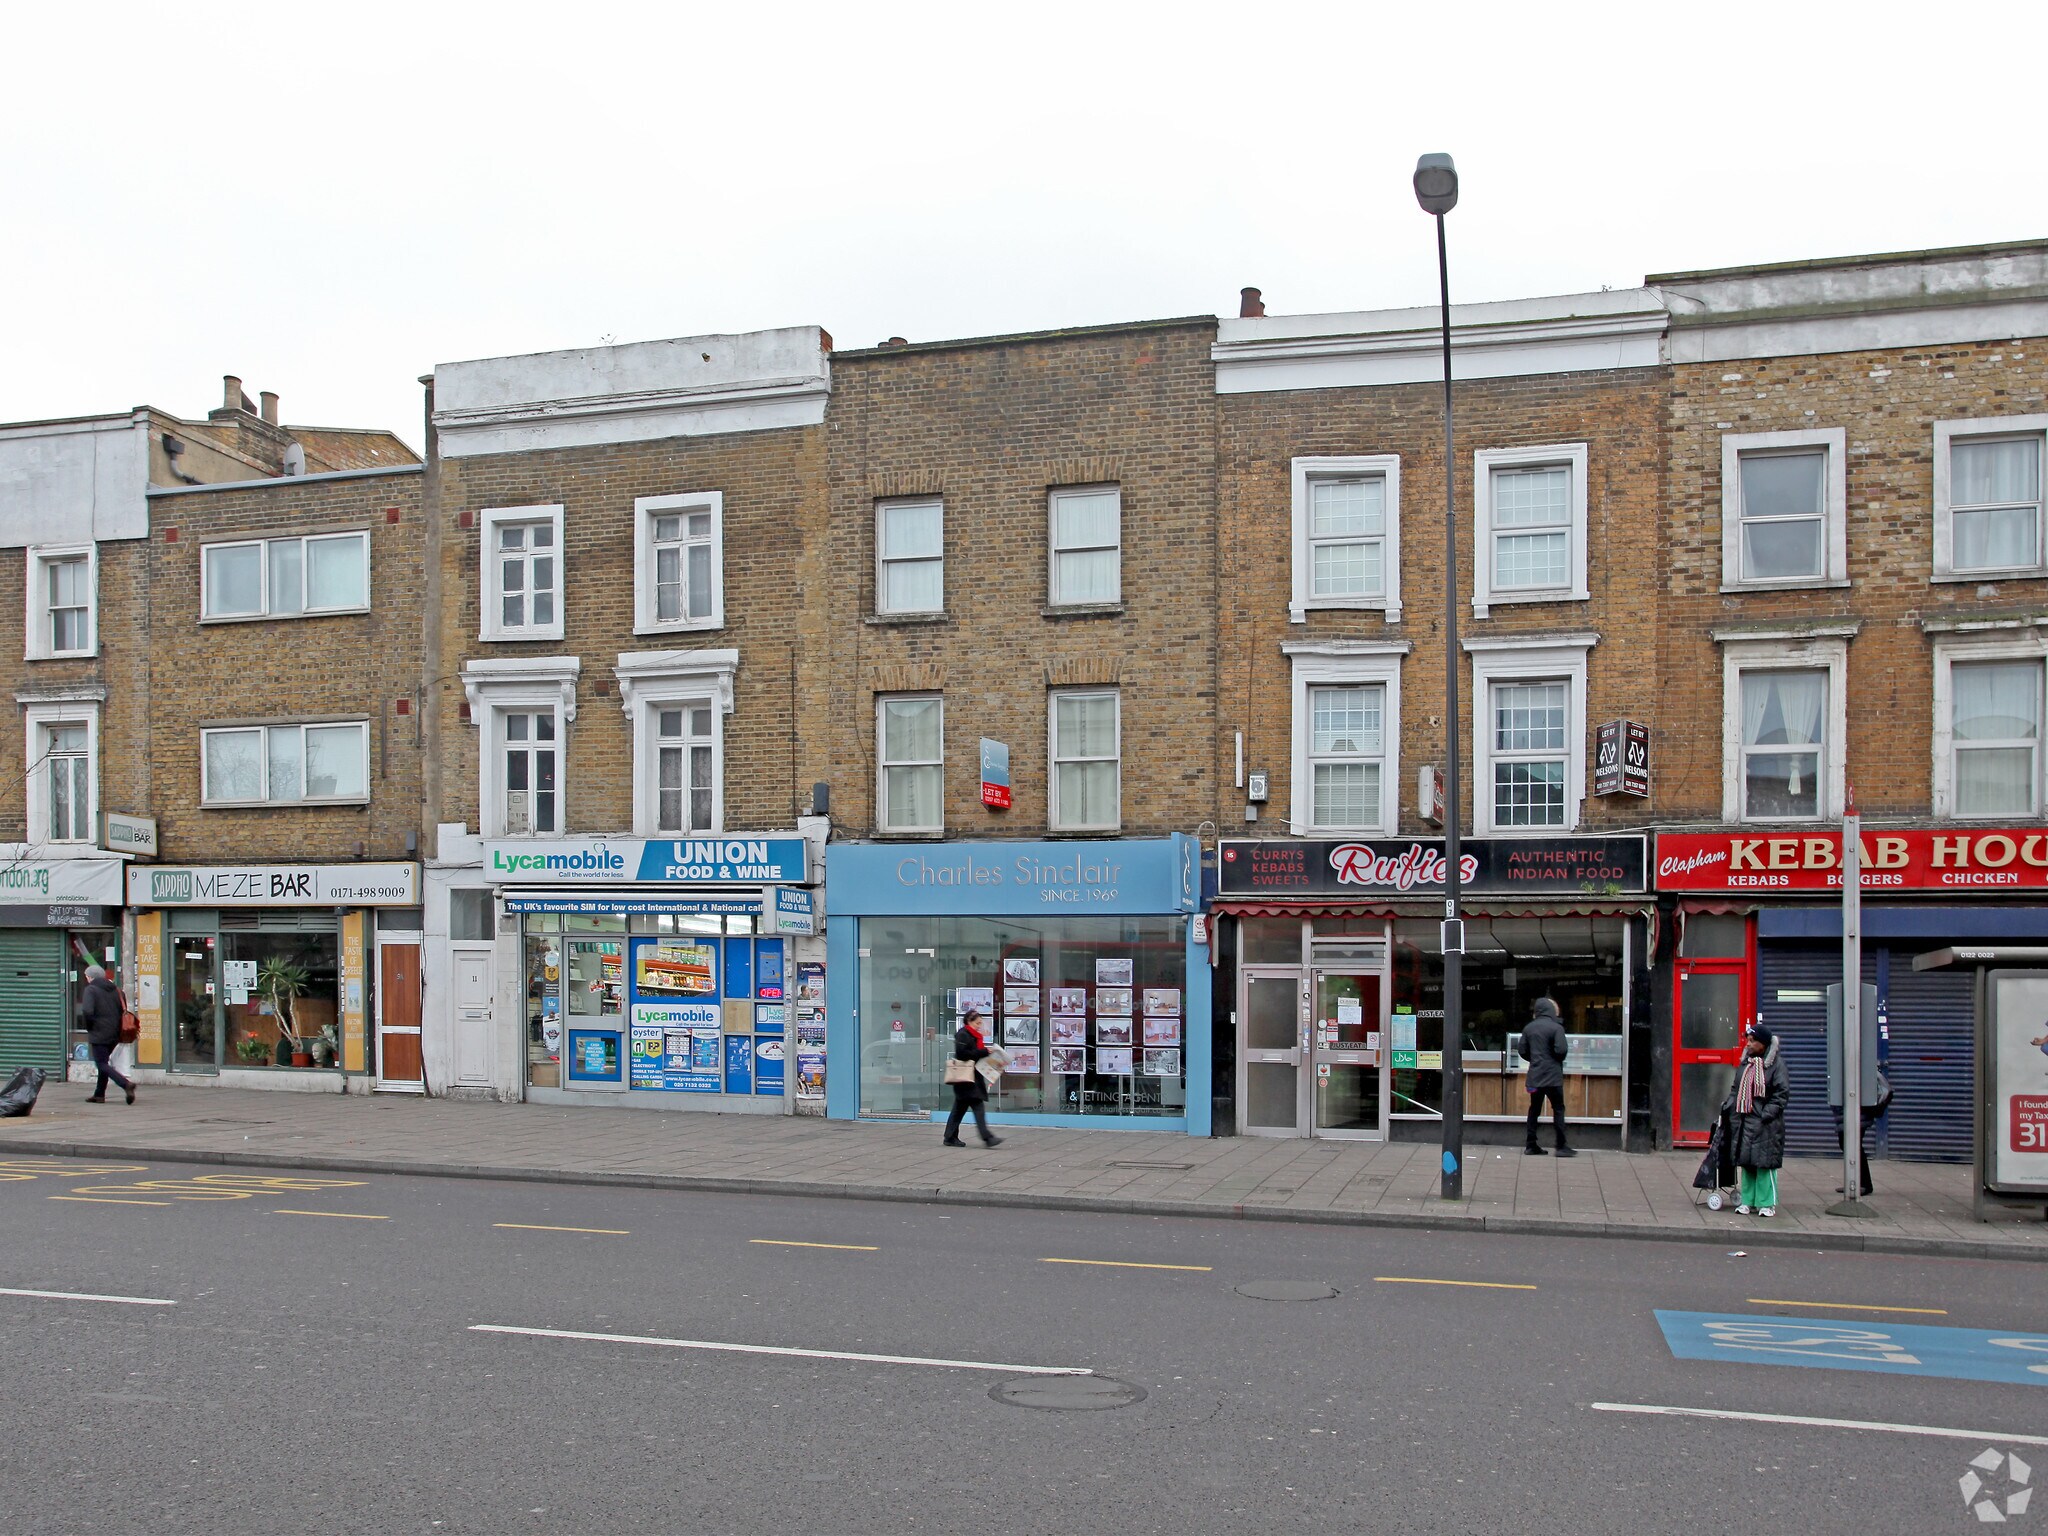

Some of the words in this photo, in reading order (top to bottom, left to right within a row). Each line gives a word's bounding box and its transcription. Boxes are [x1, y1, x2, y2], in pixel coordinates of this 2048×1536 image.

[1596, 764, 1618, 777] NELSONS
[1625, 765, 1647, 778] NELSONS
[134, 833, 151, 844] BAR
[673, 842, 768, 864] UNION
[1252, 850, 1304, 861] CURRYS
[1509, 851, 1605, 863] AUTHENTIC
[494, 848, 624, 873] Lycamobile
[1659, 849, 1727, 876] Clapham
[665, 865, 714, 879] FOOD
[719, 865, 731, 879] &
[736, 865, 782, 879] WINE
[897, 855, 1003, 886] Charles
[1015, 853, 1122, 886] Sinclair
[1252, 863, 1304, 873] KEBABS
[1331, 845, 1476, 889] Rufies
[131, 872, 137, 880] 9
[403, 868, 410, 878] 9
[1507, 868, 1568, 879] INDIAN
[1576, 867, 1624, 879] FOOD
[1252, 876, 1309, 885] SWEETS
[1727, 875, 1789, 886] KEBABS
[1826, 874, 1903, 886] BGERS
[1941, 873, 2019, 884] CHICKEN
[153, 874, 190, 898] SAPPHO
[195, 873, 263, 898] MEZE
[270, 873, 312, 898] BAR
[330, 887, 377, 898] 0171-498
[378, 887, 405, 898] 9009
[781, 890, 807, 905] UNION
[49, 906, 61, 915] SAT
[507, 903, 522, 911] The
[524, 903, 542, 911] UK's
[543, 903, 579, 911] favourite
[581, 903, 596, 911] SIM
[597, 903, 610, 911] for
[611, 903, 626, 911] low
[627, 903, 646, 911] cost
[647, 903, 700, 912] International
[702, 904, 709, 912] &
[711, 904, 746, 912] National
[778, 917, 811, 930] Lycamobile
[139, 935, 150, 943] EAT
[151, 935, 159, 943] IN
[347, 937, 359, 945] THE
[344, 947, 362, 955] TASTE
[140, 954, 158, 963] TAKE
[350, 957, 357, 965] OF
[140, 964, 159, 972] AWAY
[637, 1008, 714, 1024] Lycamobile
[632, 1029, 659, 1037] oyster
[1069, 1091, 1078, 1102] &
[1079, 1092, 1121, 1102] ETTING
[2020, 1112, 2033, 1121] my
[2019, 1122, 2046, 1147] 31
